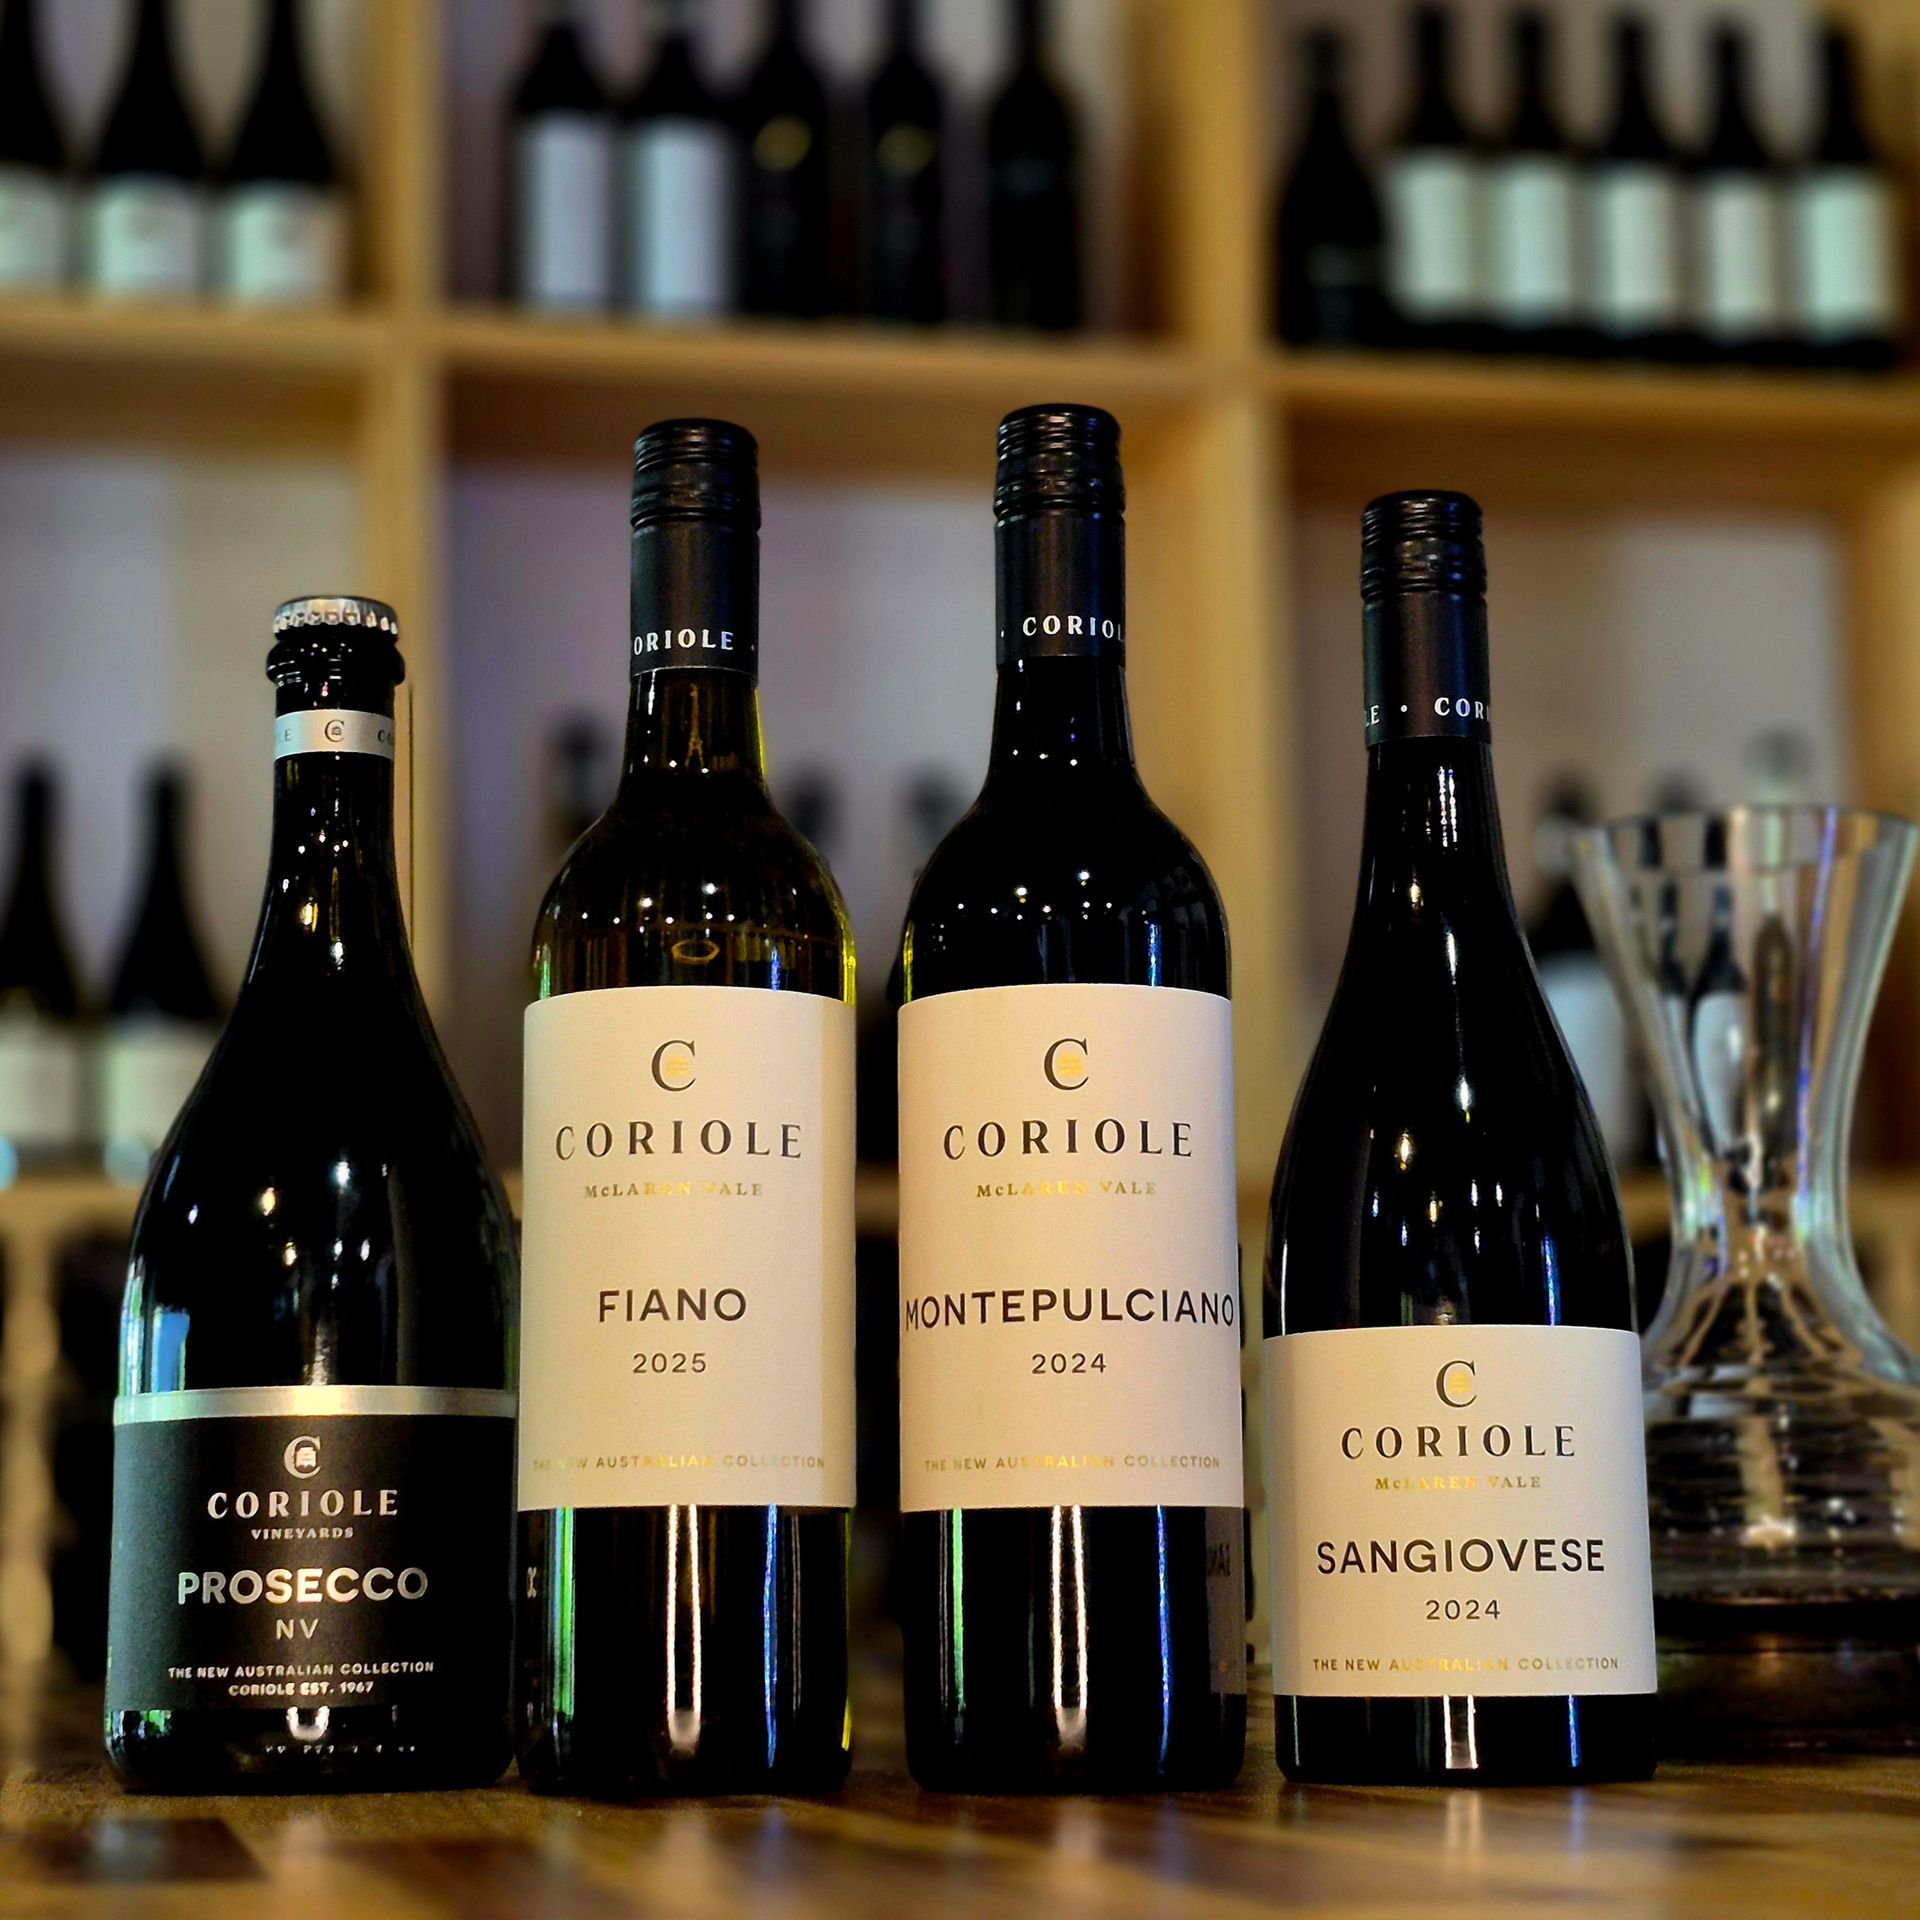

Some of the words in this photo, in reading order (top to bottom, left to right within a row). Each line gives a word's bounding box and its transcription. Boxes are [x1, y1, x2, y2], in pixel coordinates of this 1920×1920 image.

[556, 1120, 802, 1161] CORIOLE
[943, 1118, 1192, 1161] CORIOLE
[584, 1181, 692, 1199] McLAREN
[704, 1182, 763, 1196] VALE
[976, 1180, 1088, 1198] McLAREN
[1100, 1181, 1157, 1195] VALE
[599, 1288, 747, 1322] FIANO
[905, 1287, 1235, 1331] MONTEPULCIANO
[632, 1352, 707, 1374] 2025
[1031, 1352, 1107, 1374] 2024
[1341, 1425, 1576, 1460] CORIOLE
[595, 1455, 713, 1469] AUSTRALIAN
[924, 1460, 946, 1471] THE
[953, 1458, 987, 1470] NEW
[995, 1455, 1115, 1469] AUSTRALIAN
[1124, 1455, 1220, 1469] COLLECTION
[1374, 1476, 1478, 1490] McLAREN
[1487, 1476, 1542, 1489] VALE
[207, 1489, 399, 1520] CORIOLE
[250, 1527, 355, 1541] VINEYARDS
[1316, 1538, 1606, 1575] SANGIOVESE
[177, 1567, 429, 1606] PROSECCO
[1425, 1599, 1502, 1621] 2024
[275, 1618, 320, 1641] NV
[167, 1667, 193, 1679] THE
[197, 1666, 230, 1679] NEW
[234, 1664, 335, 1678] AUSTRALIAN
[340, 1661, 435, 1675] COLLECTION
[1312, 1658, 1338, 1671] THE
[1344, 1658, 1380, 1671] NEW
[1389, 1658, 1509, 1672] AUSTRALIAN
[1518, 1657, 1619, 1670] COLLECTION
[228, 1683, 296, 1697] CORIOLE
[299, 1681, 335, 1696] EST.
[339, 1681, 375, 1695] 1967
